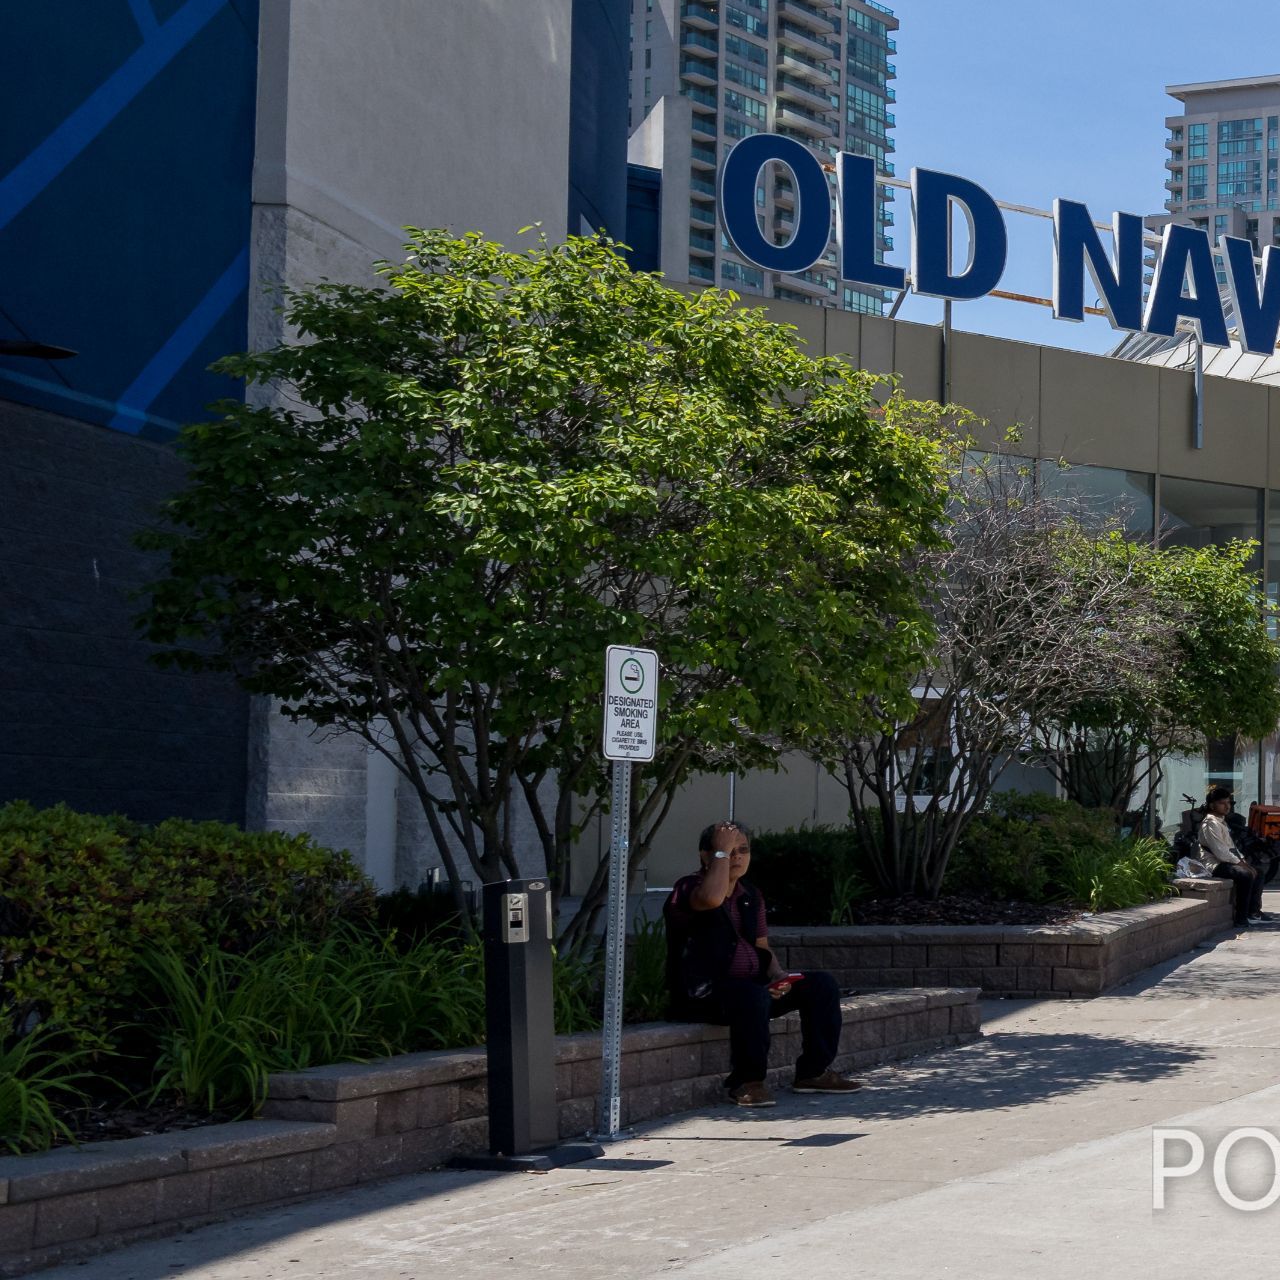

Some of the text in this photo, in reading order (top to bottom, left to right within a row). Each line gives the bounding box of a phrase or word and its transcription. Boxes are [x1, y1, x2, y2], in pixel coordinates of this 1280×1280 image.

[720, 133, 1007, 300] OLD
[608, 695, 654, 709] DESIGNATED
[614, 707, 648, 719] SMOKING
[620, 718, 640, 729] AREA
